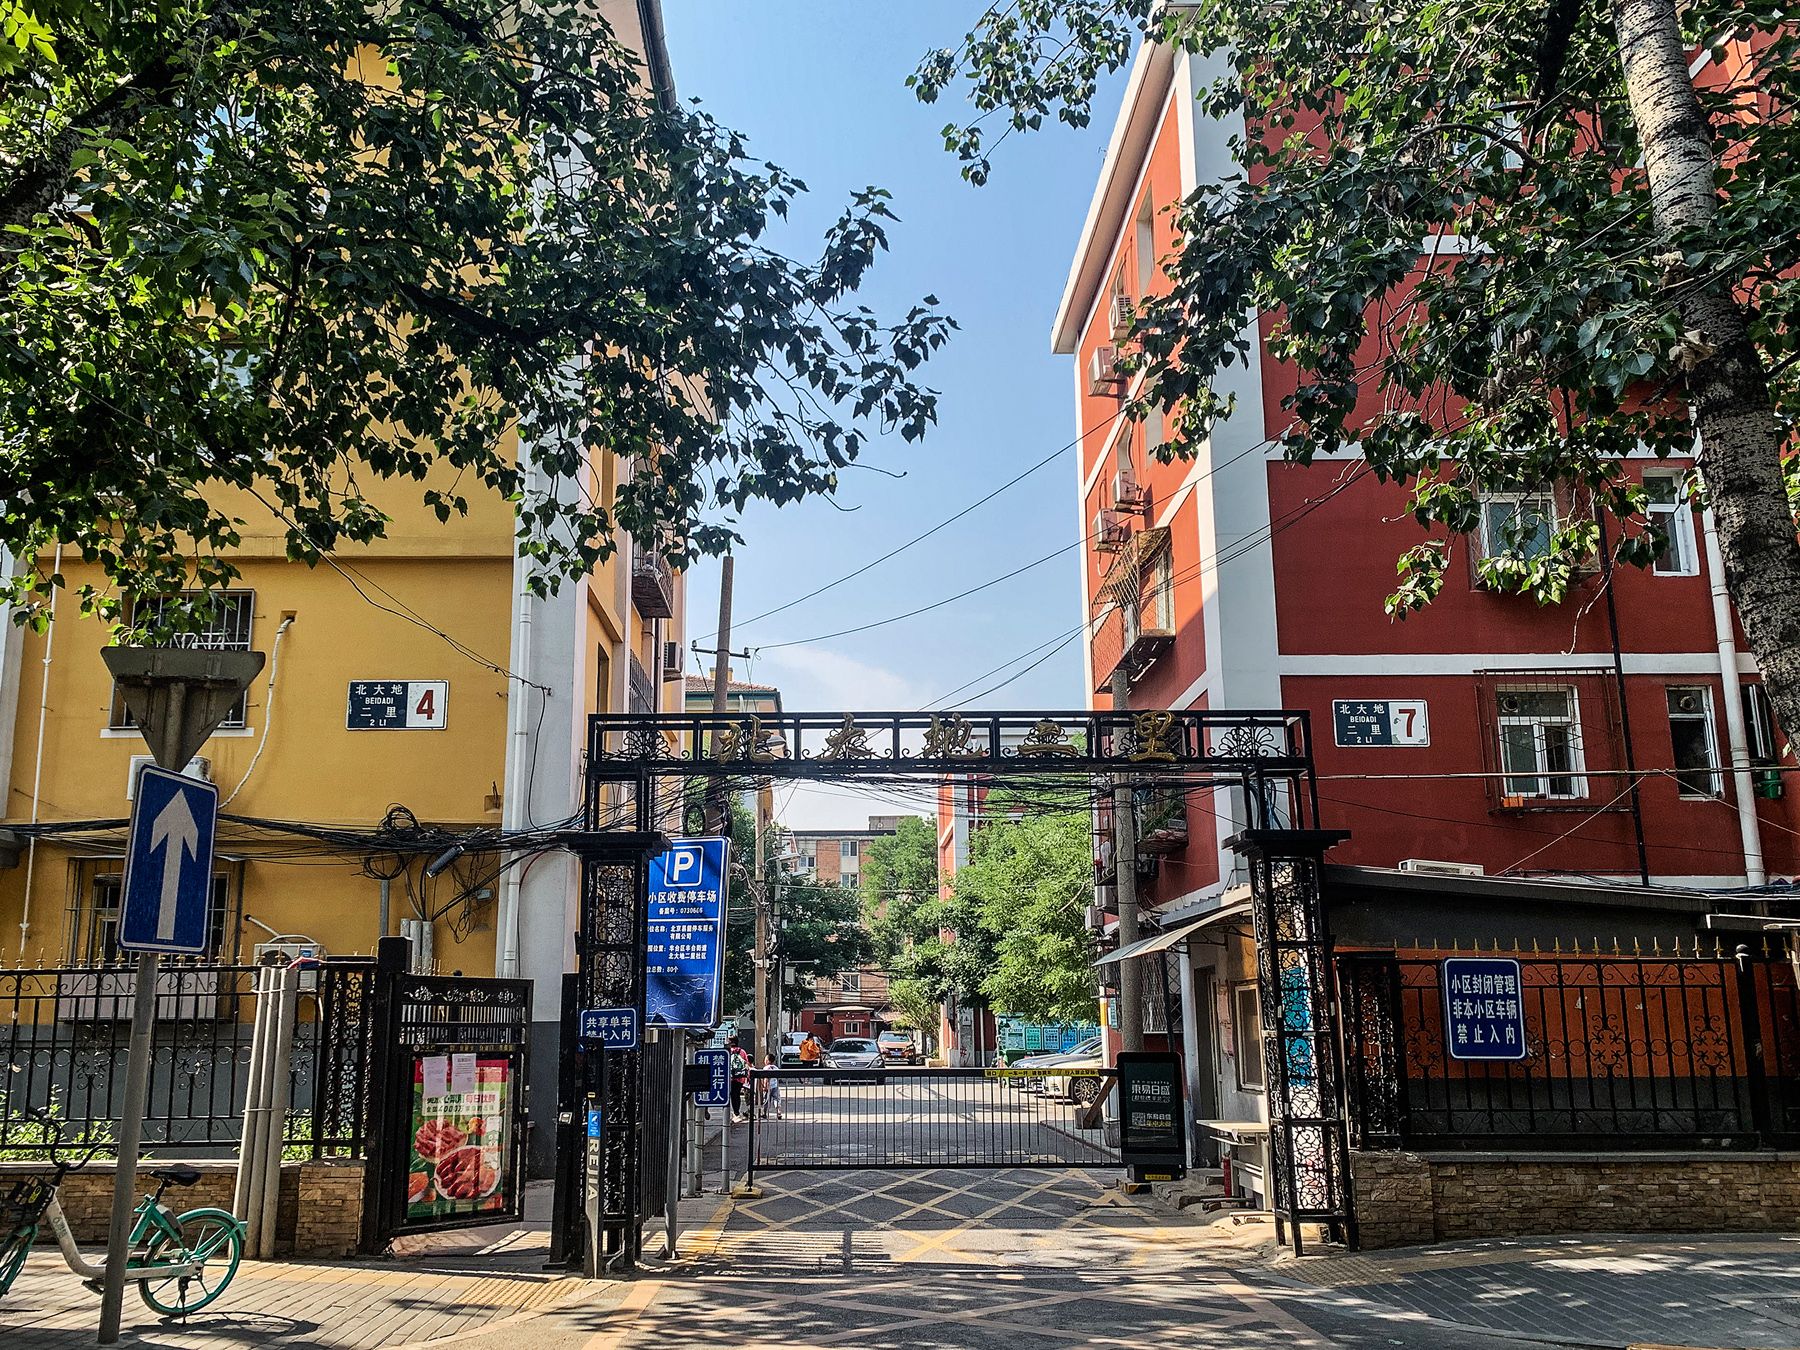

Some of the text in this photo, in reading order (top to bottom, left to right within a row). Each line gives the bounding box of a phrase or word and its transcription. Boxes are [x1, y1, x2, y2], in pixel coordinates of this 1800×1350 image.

[355, 684, 403, 696] 北大地
[365, 697, 394, 705] BEIDADI
[416, 689, 435, 720] 4
[1339, 703, 1385, 715] 北大地
[360, 706, 397, 718] 二里
[1350, 715, 1377, 723] BEIDADI
[1347, 724, 1382, 735] 二里
[1398, 708, 1417, 738] 7
[672, 851, 694, 882] P
[648, 890, 717, 904] 小区收费停车场
[1451, 974, 1516, 995] 小区封闭管理
[1453, 998, 1517, 1020] 非本小区车辆
[586, 1016, 632, 1028] 共享单车
[1457, 1023, 1516, 1044] 禁止入内
[697, 1055, 711, 1102] 机道
[712, 1054, 725, 1102] 禁止行人
